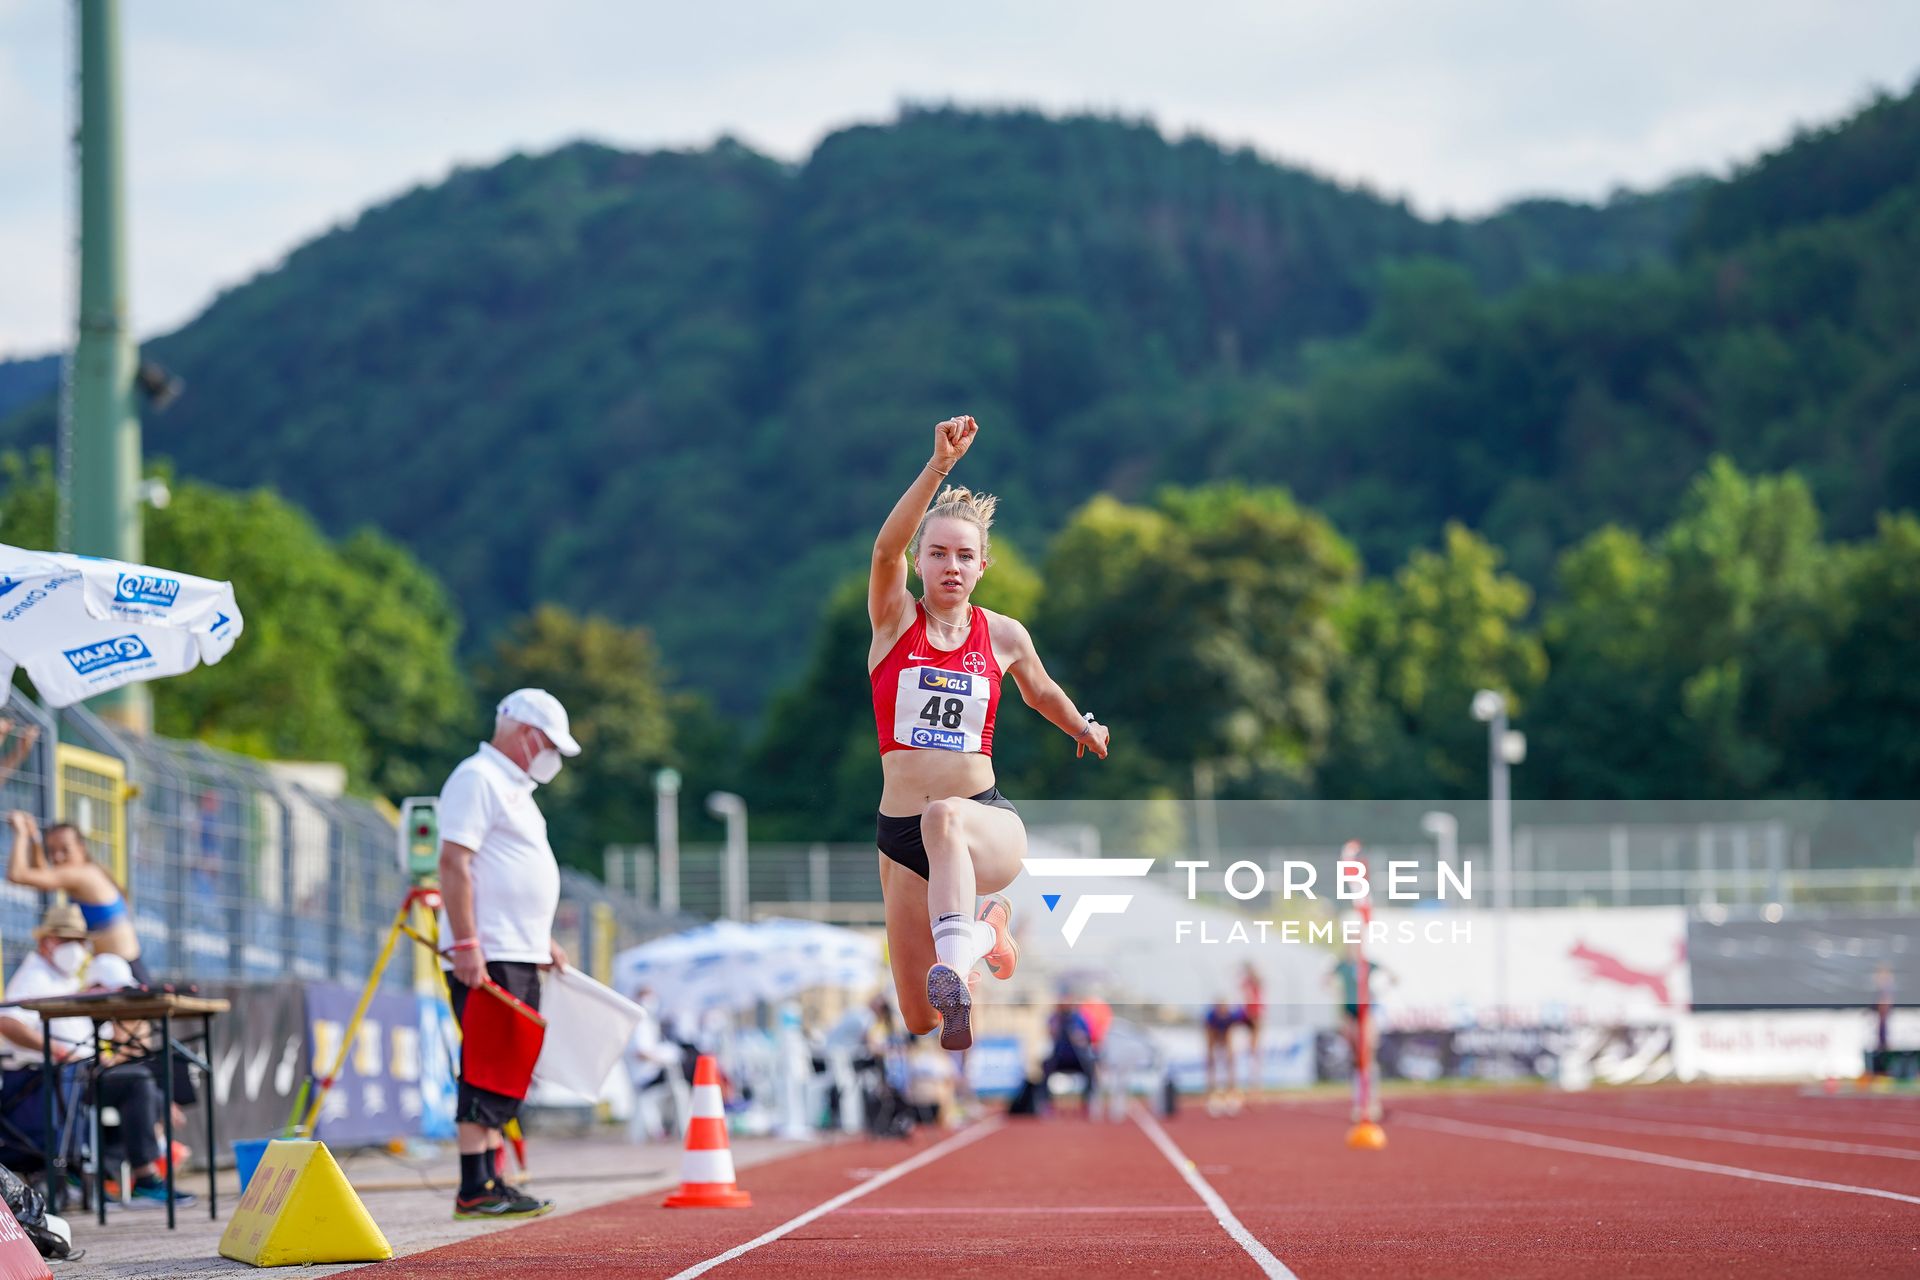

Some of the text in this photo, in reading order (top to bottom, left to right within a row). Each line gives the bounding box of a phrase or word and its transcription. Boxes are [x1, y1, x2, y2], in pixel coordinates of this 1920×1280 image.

[142, 577, 178, 596] PLAN
[948, 679, 968, 691] GLS
[920, 696, 964, 729] 48
[934, 733, 962, 745] PLAN
